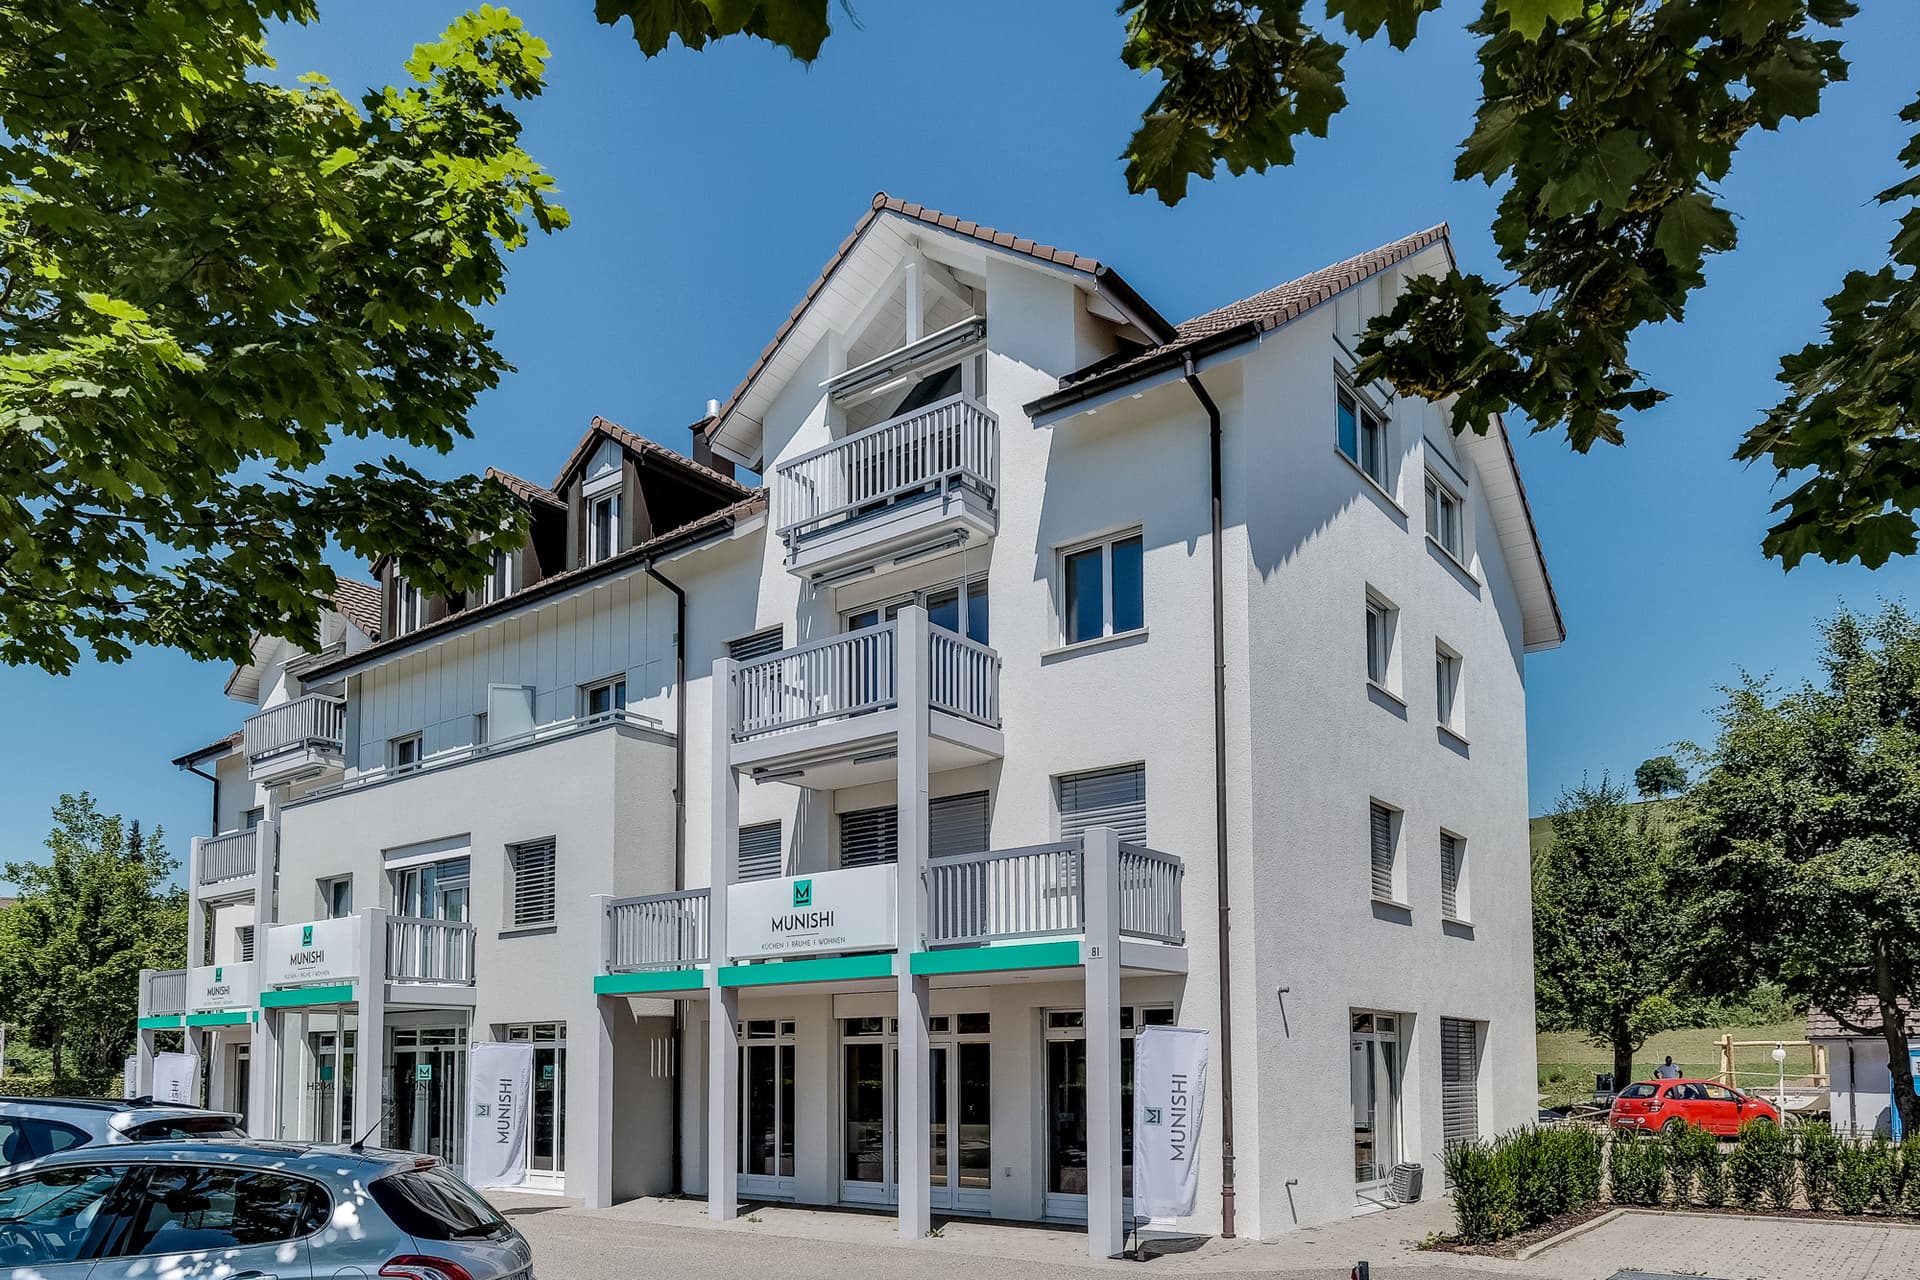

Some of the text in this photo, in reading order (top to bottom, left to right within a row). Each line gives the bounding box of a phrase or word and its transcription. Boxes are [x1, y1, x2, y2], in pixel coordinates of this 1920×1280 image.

[771, 911, 834, 932] MUNISHI
[818, 936, 846, 945] WOHNEN
[290, 950, 325, 966] MUNISHI
[1091, 946, 1100, 957] 81
[497, 1078, 513, 1144] MUNISHI
[1170, 1073, 1188, 1161] MUNISHI
